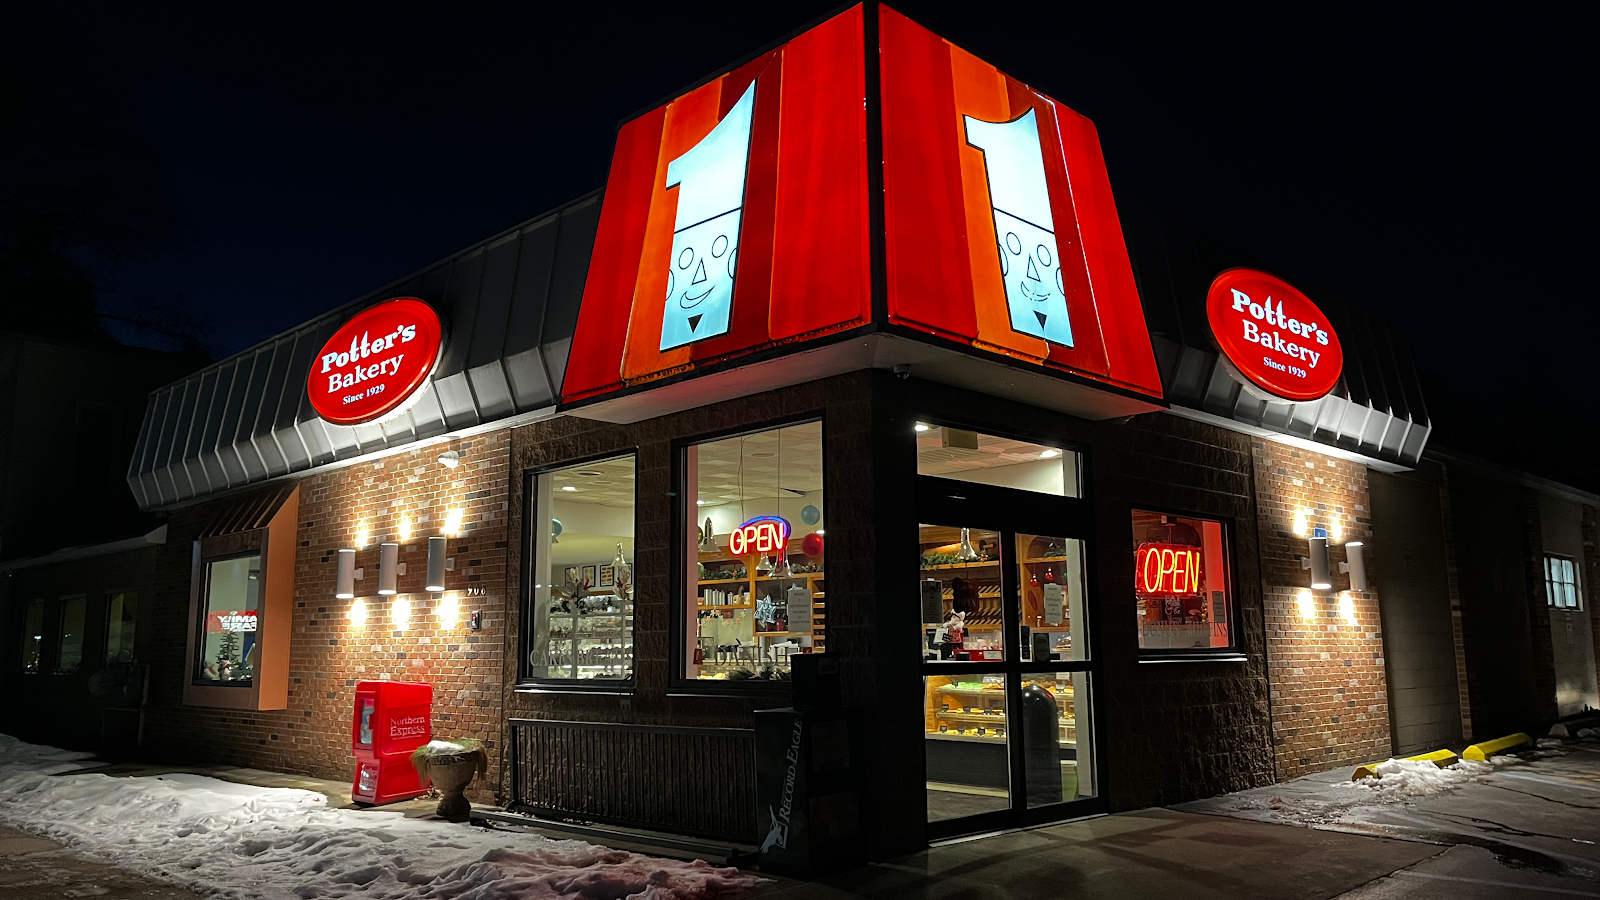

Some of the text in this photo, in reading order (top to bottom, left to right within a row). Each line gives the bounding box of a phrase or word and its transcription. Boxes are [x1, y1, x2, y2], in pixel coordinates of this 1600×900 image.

[1230, 288, 1329, 346] Potter's
[320, 324, 417, 374] Potter's
[1242, 319, 1321, 369] Bakery
[327, 353, 405, 394] Bakery
[1263, 356, 1307, 379] Since 1929
[343, 384, 386, 405] Since 1929
[730, 522, 784, 555] OPEN
[1143, 547, 1200, 593] OPEN
[530, 649, 574, 667] CAKES
[715, 645, 790, 667] DANISH
[389, 725, 425, 738] Express
[390, 716, 425, 727] Northern
